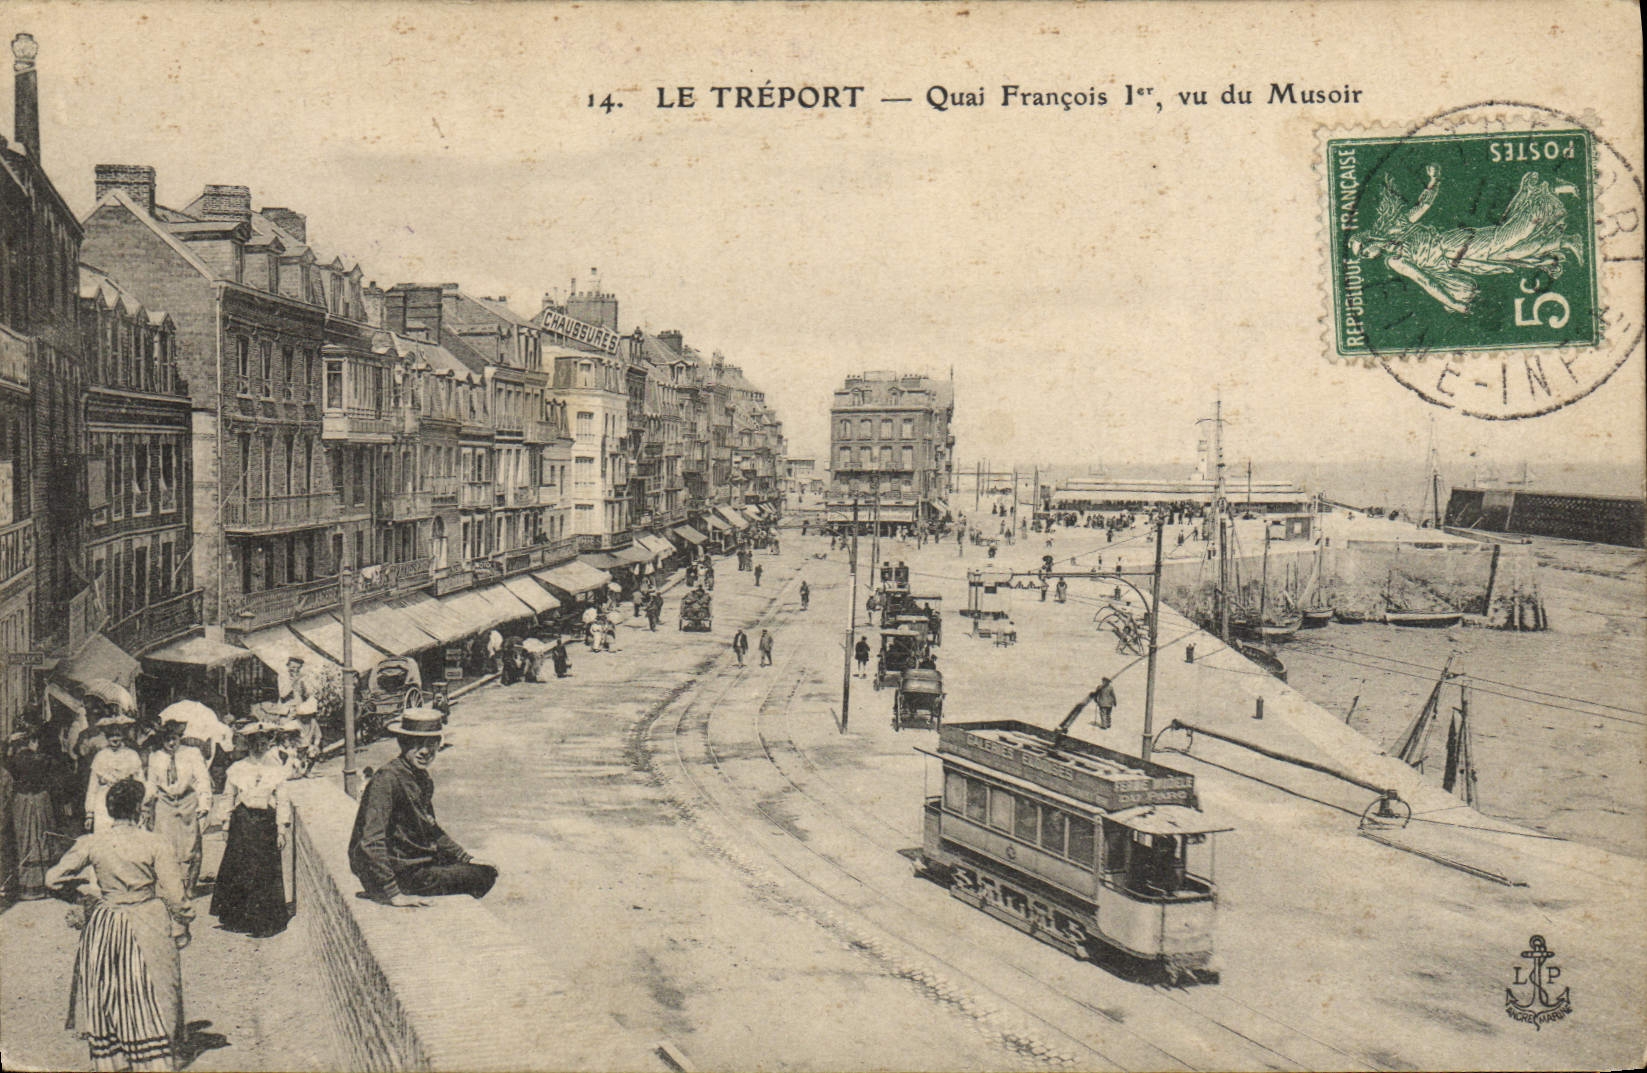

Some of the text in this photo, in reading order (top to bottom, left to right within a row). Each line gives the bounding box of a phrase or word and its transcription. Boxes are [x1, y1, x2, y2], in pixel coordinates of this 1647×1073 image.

[1489, 140, 1575, 163] POSTES
[1339, 148, 1360, 231] FRANÇAISE
[543, 310, 618, 351] CHAUSSURES
